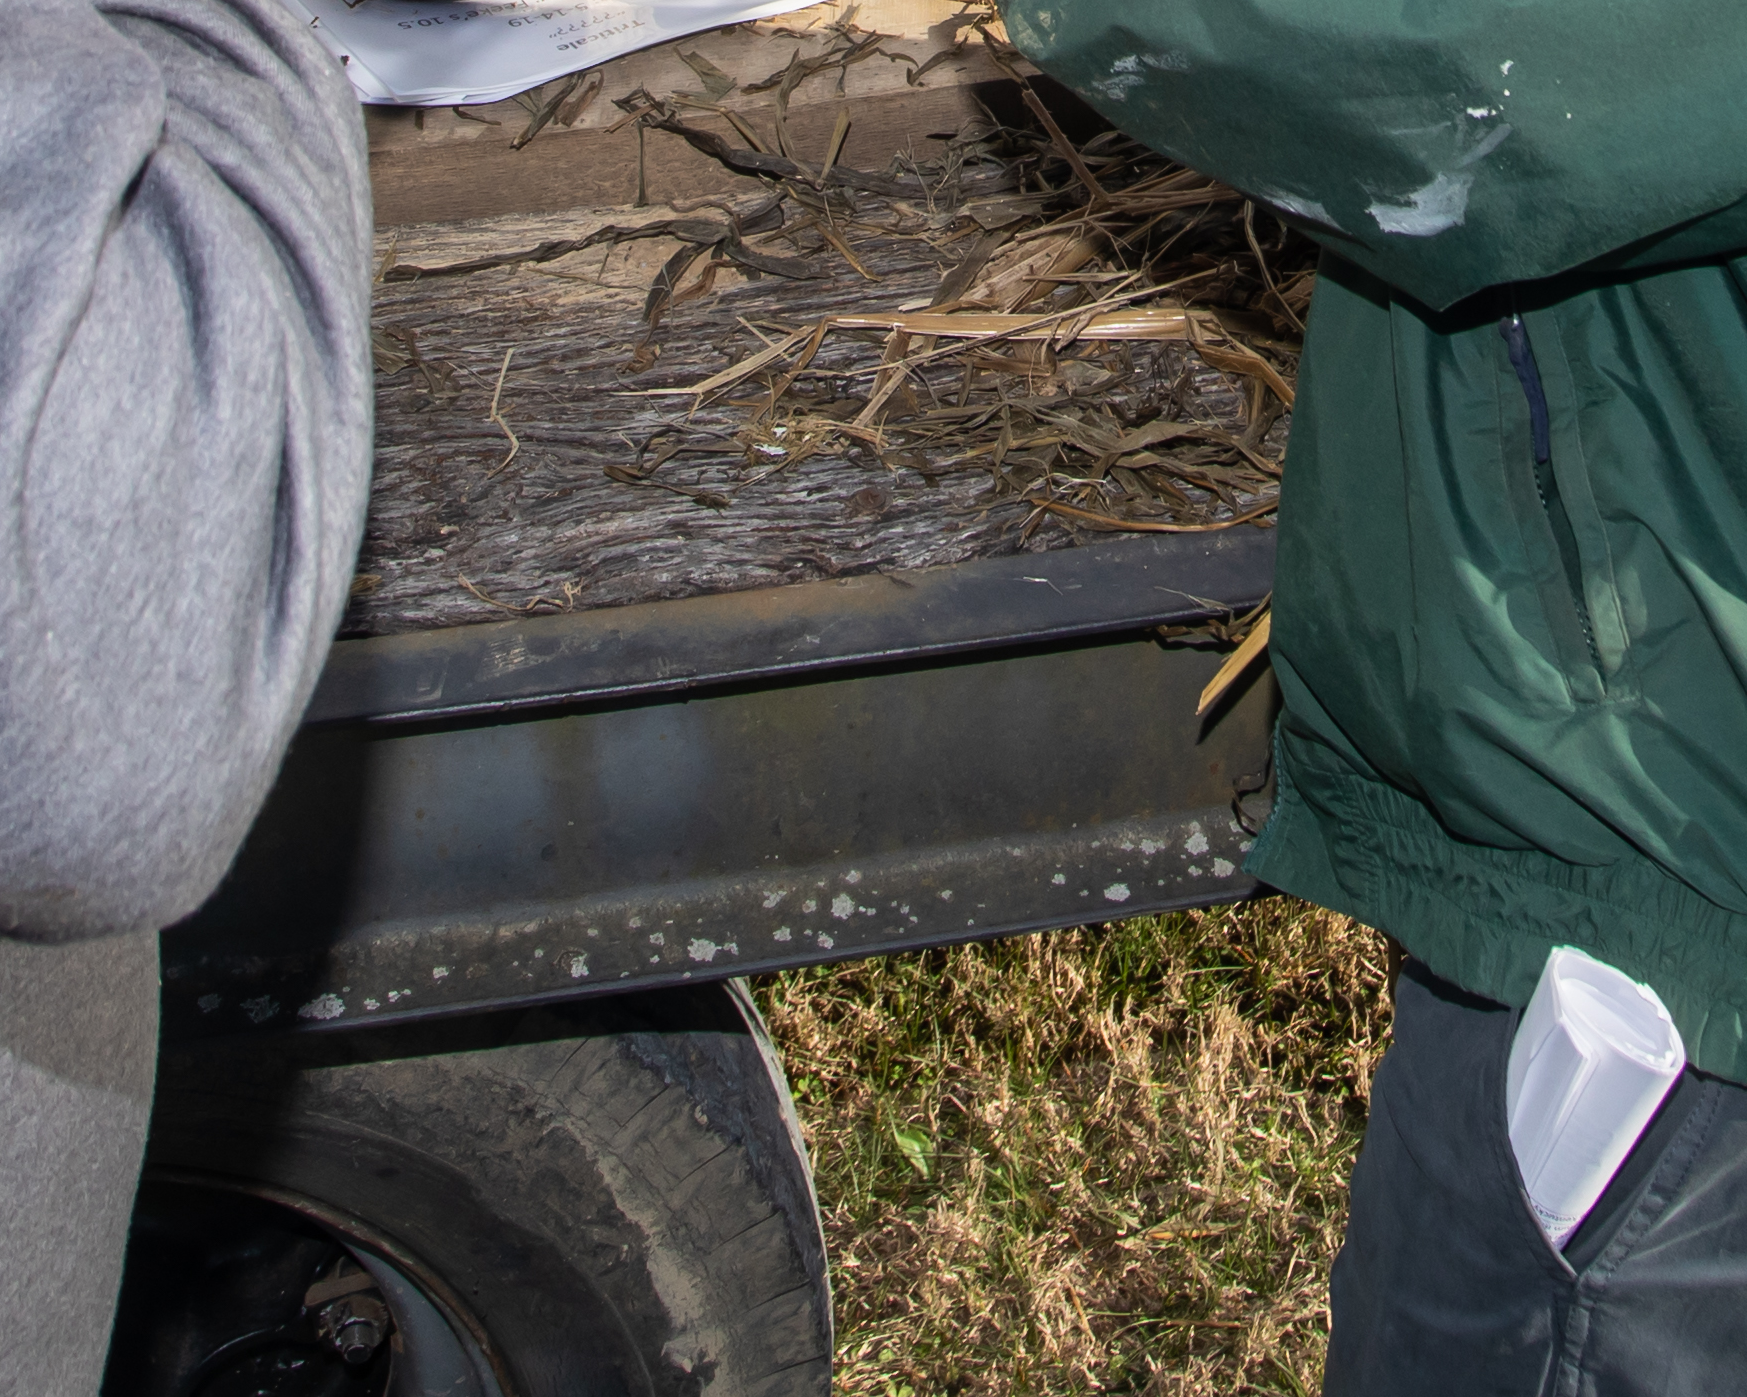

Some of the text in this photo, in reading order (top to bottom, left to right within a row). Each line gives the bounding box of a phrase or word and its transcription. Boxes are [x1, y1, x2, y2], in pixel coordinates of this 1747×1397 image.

[397, 16, 445, 31] 10.5
[507, 2, 588, 28] 5-14-19
[556, 19, 646, 52] Triticale
